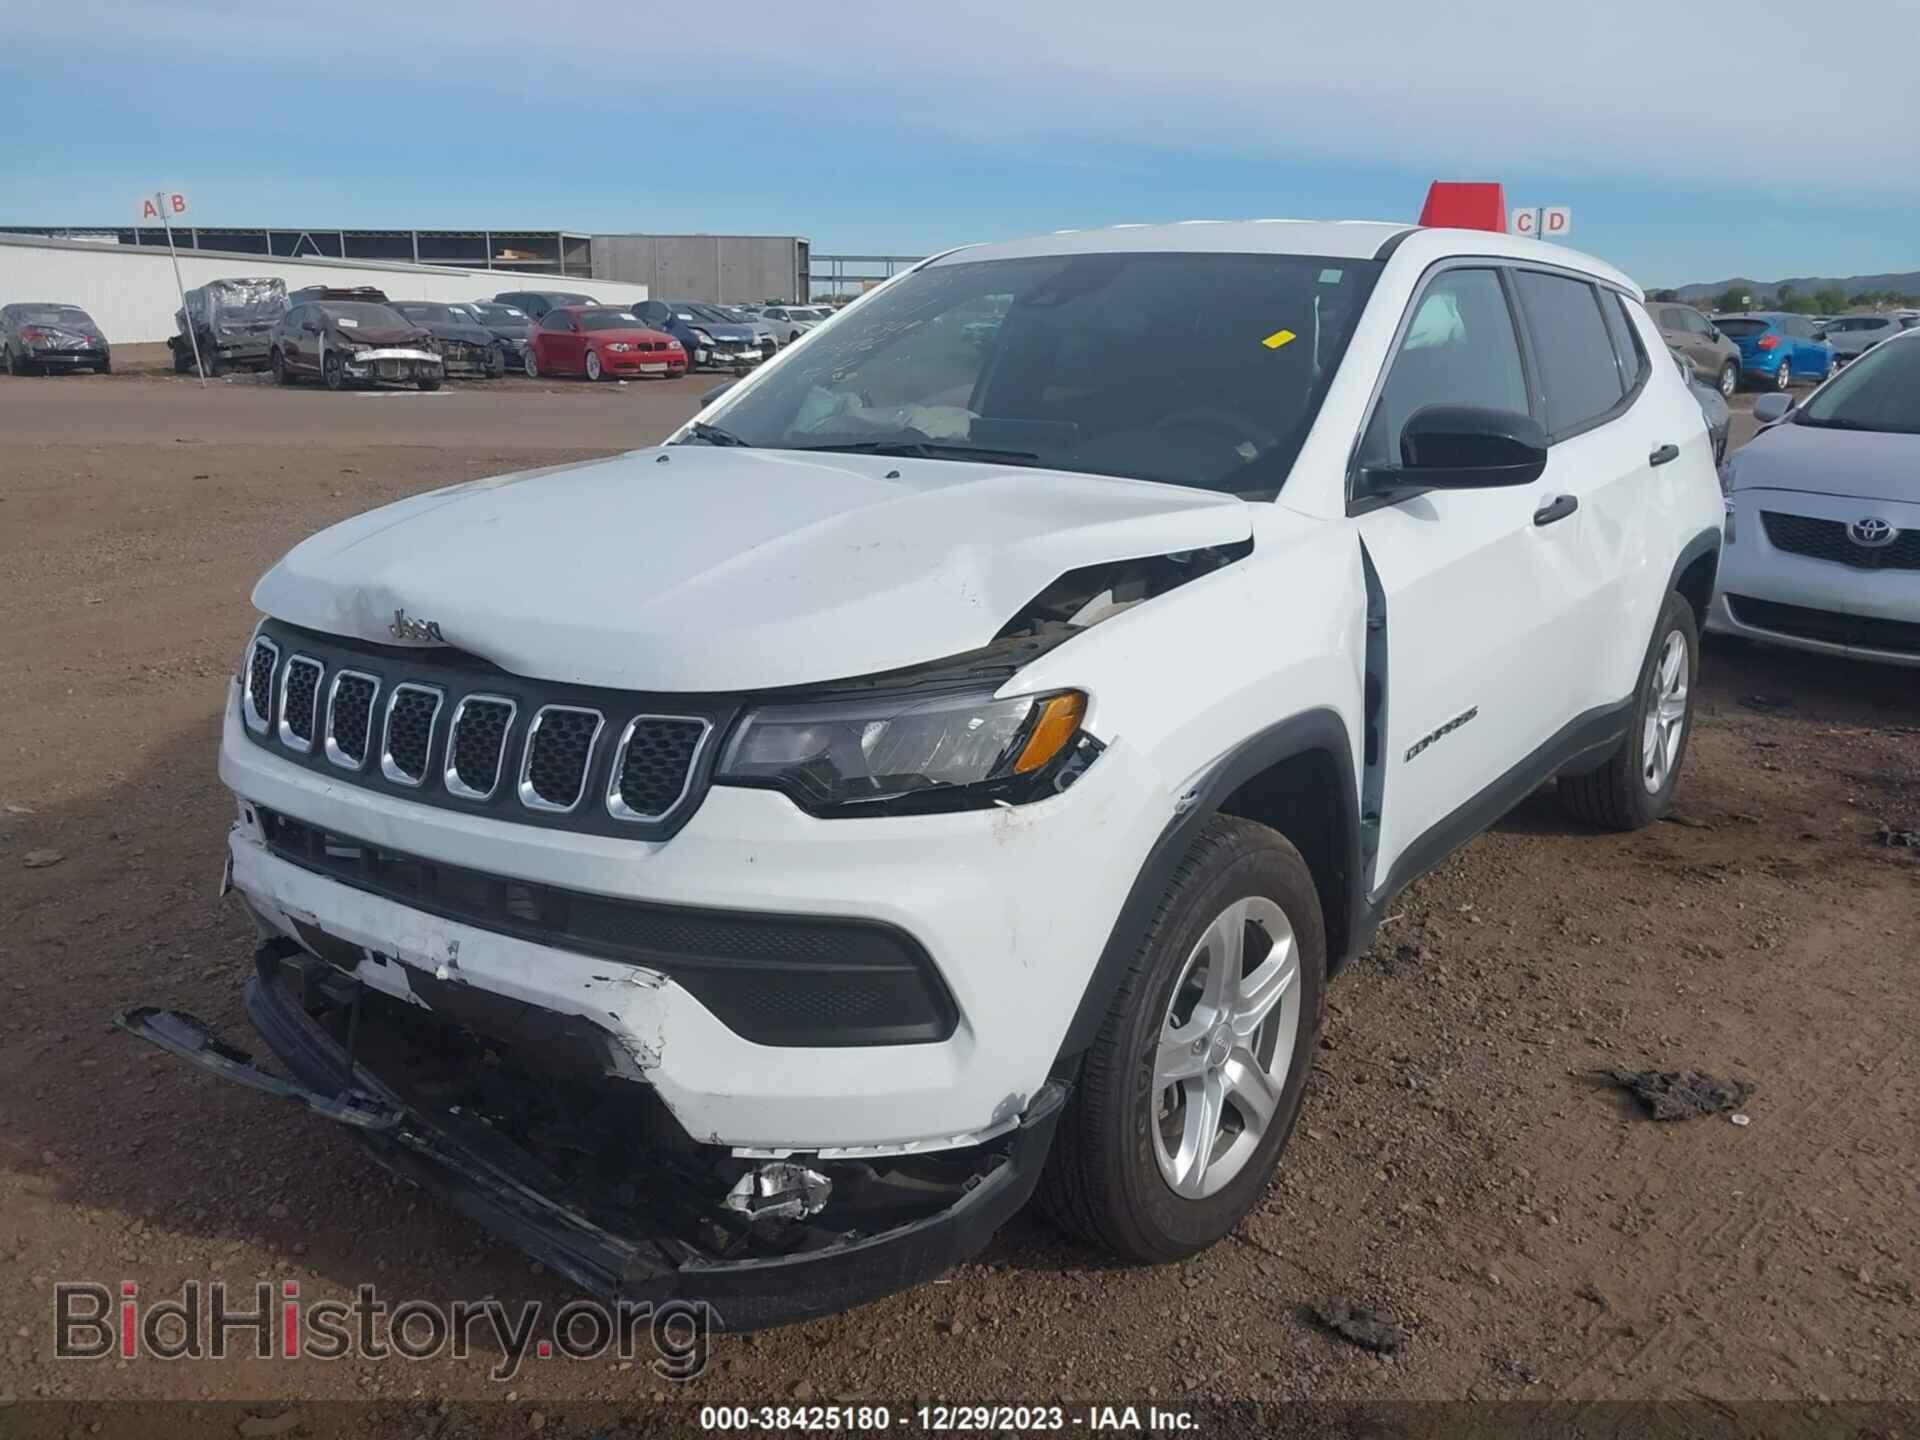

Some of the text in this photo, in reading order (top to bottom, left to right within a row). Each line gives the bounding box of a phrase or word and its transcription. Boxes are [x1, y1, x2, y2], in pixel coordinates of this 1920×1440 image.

[143, 200, 157, 218] A
[172, 194, 186, 213] B
[1518, 213, 1532, 232] C
[1549, 212, 1565, 230] D
